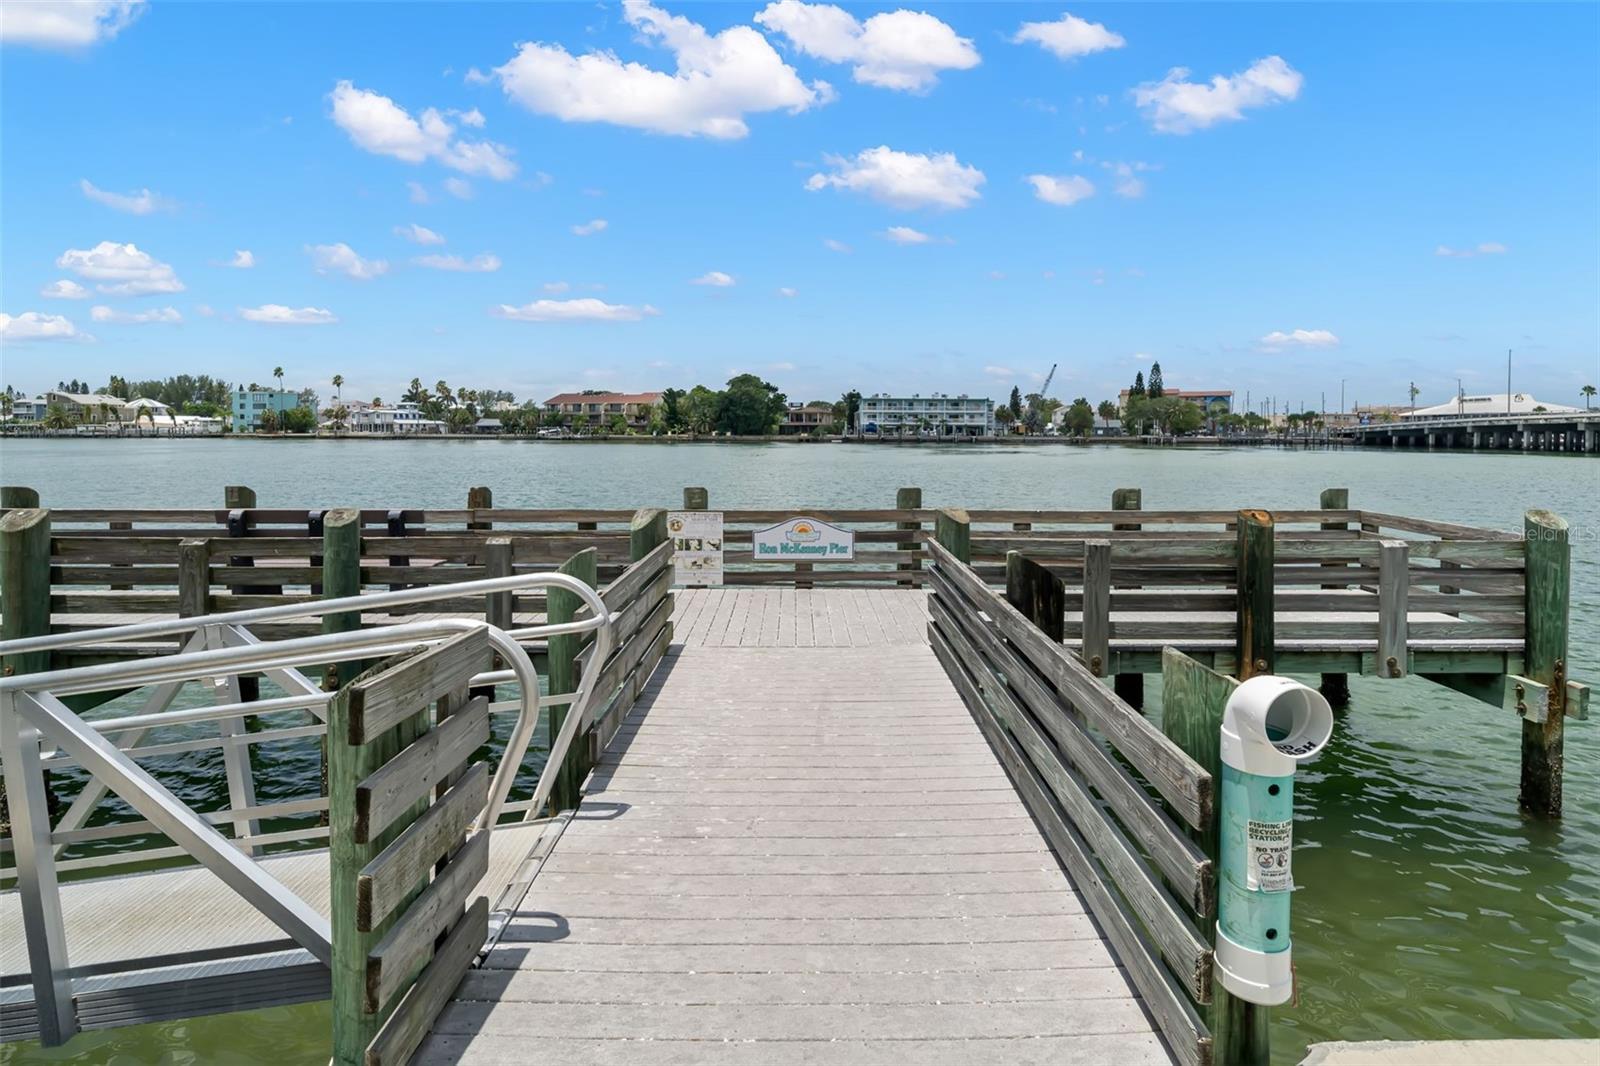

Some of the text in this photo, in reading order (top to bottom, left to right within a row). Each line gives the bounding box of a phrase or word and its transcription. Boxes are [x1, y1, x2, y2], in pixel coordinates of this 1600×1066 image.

[758, 542, 849, 556] Ron McKenney Pier
[1248, 821, 1281, 830] FISHING
[1249, 833, 1283, 842] STATION
